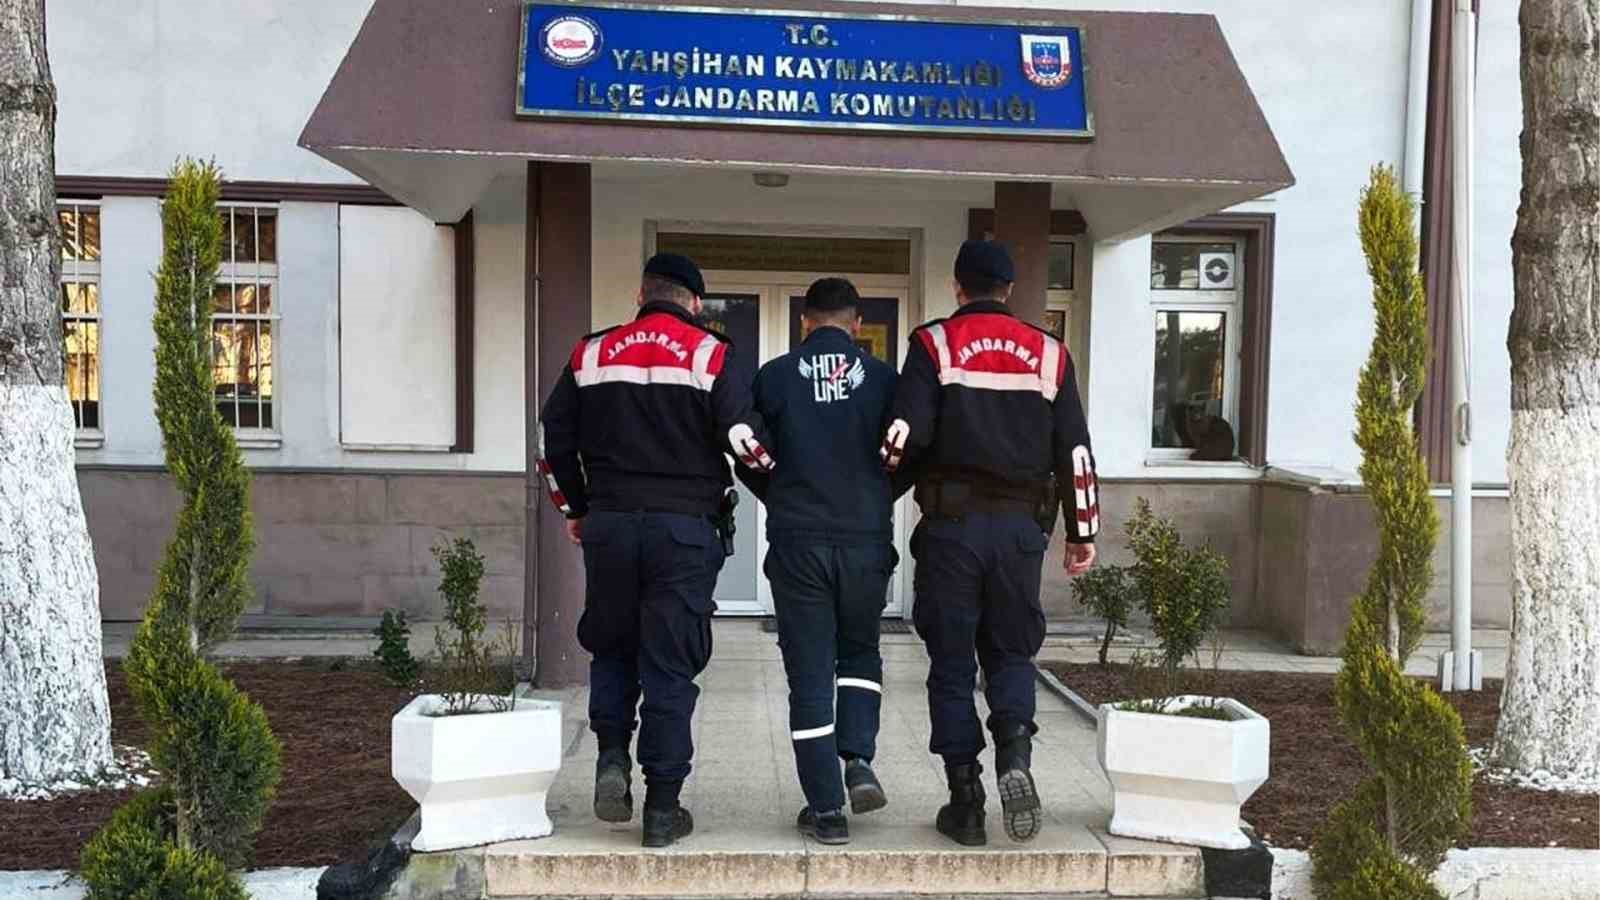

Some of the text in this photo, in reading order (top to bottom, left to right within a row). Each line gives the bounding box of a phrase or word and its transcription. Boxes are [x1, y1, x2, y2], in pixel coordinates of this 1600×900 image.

[785, 24, 839, 47] T.C.
[612, 47, 765, 79] YAHŞİHAN
[775, 55, 1002, 87] KAYMAKAMLIĞI
[576, 76, 1037, 122] İLÇE JANDARMA KOMUTANLIĞI
[607, 331, 688, 361] JANDARMA
[958, 337, 1039, 370] JANDARMA
[812, 353, 849, 380] HOT
[814, 379, 849, 404] LINE
